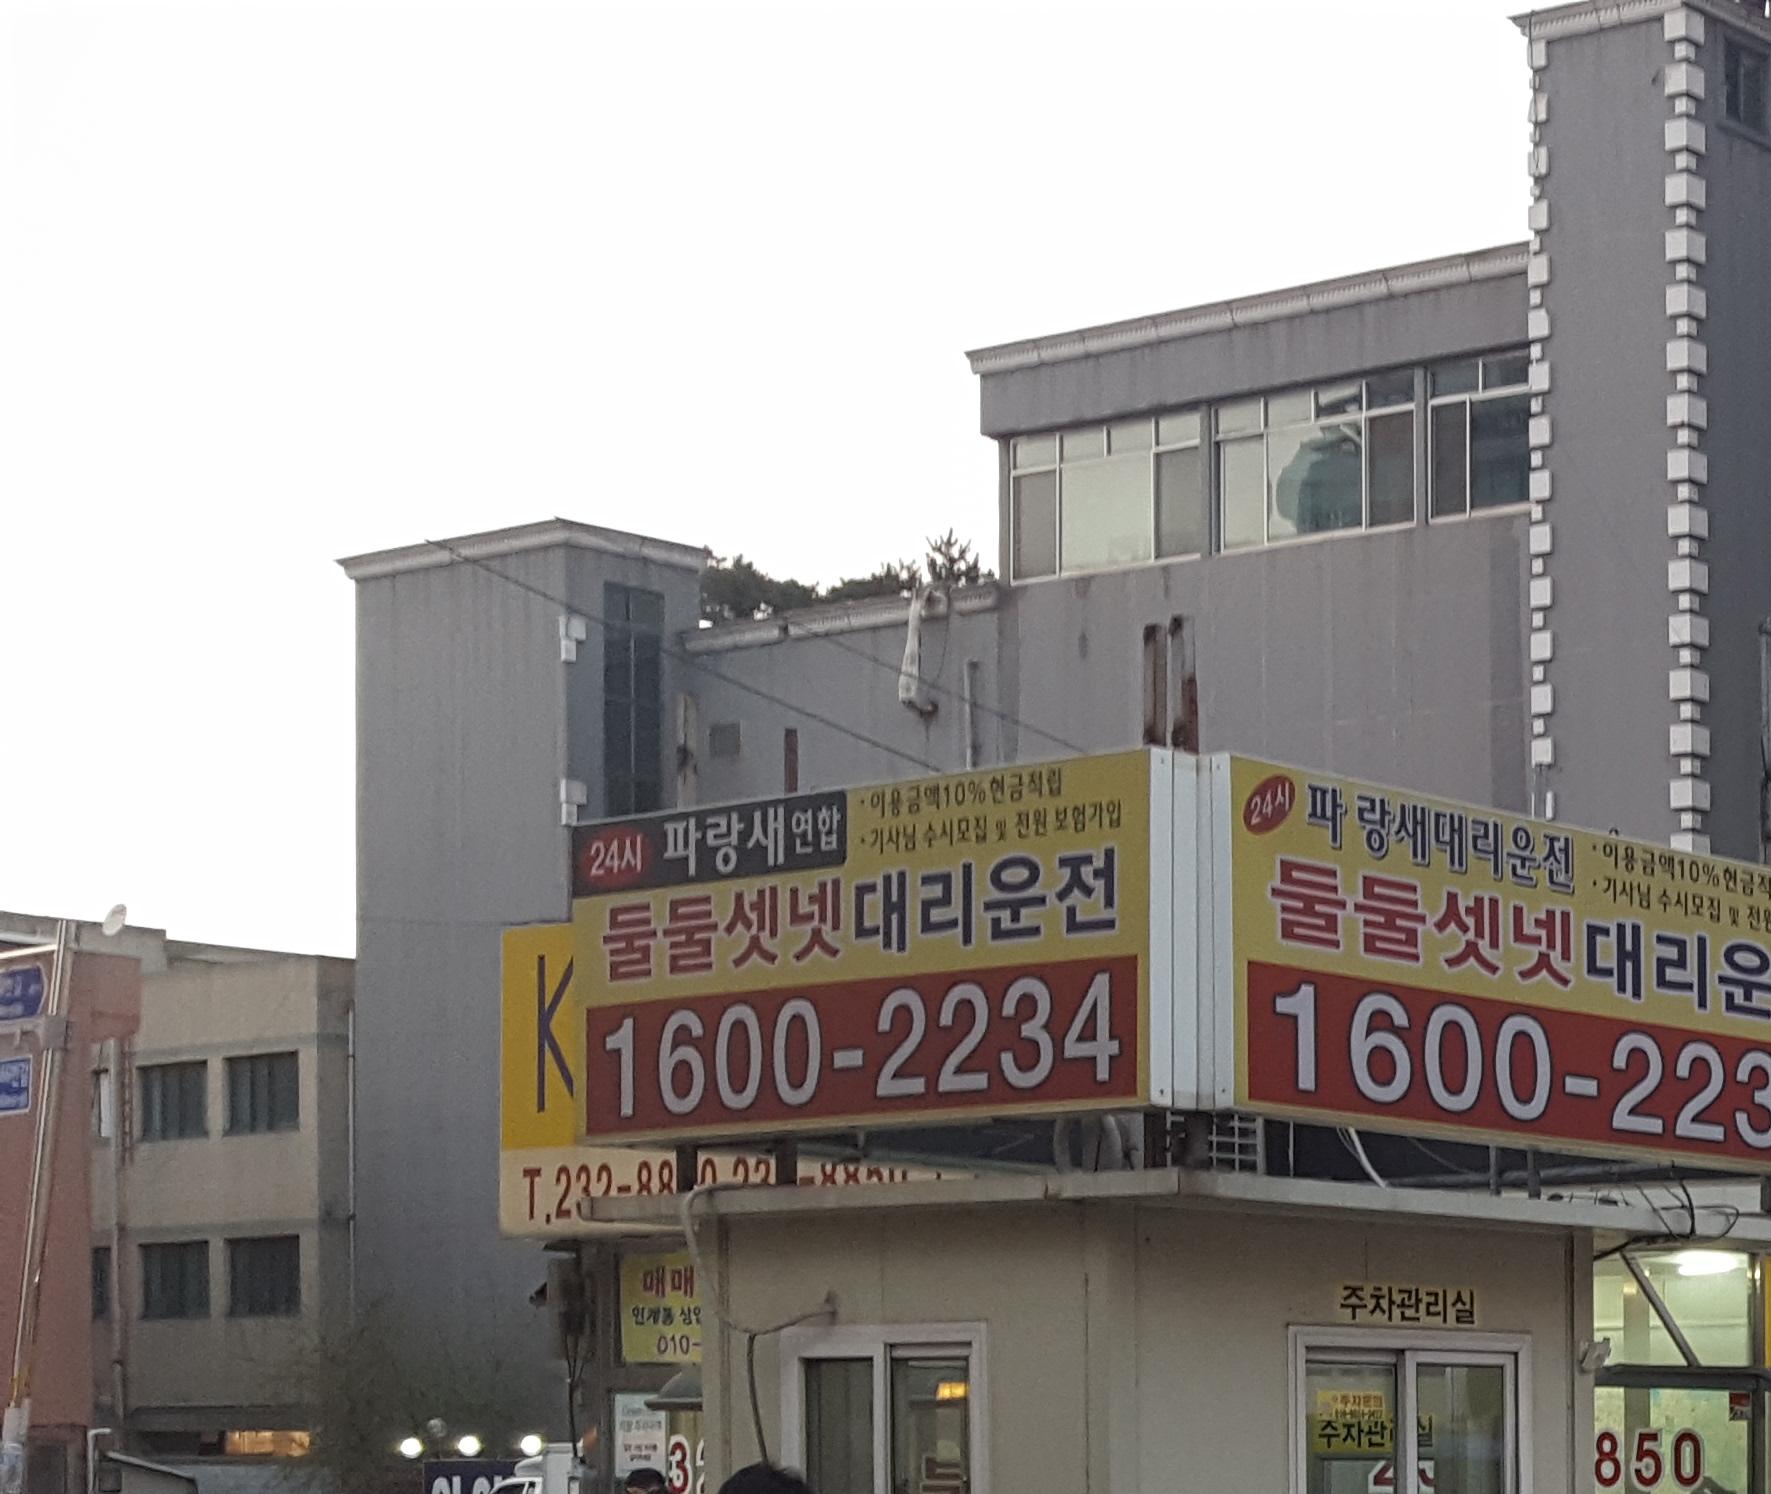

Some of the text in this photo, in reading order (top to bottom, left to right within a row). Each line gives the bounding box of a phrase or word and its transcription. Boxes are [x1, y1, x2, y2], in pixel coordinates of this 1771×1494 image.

[1250, 780, 1291, 826] 24시
[589, 833, 643, 878] 24시
[603, 971, 1121, 1119] 1600-2234
[1340, 1284, 1476, 1326] 주차관리실
